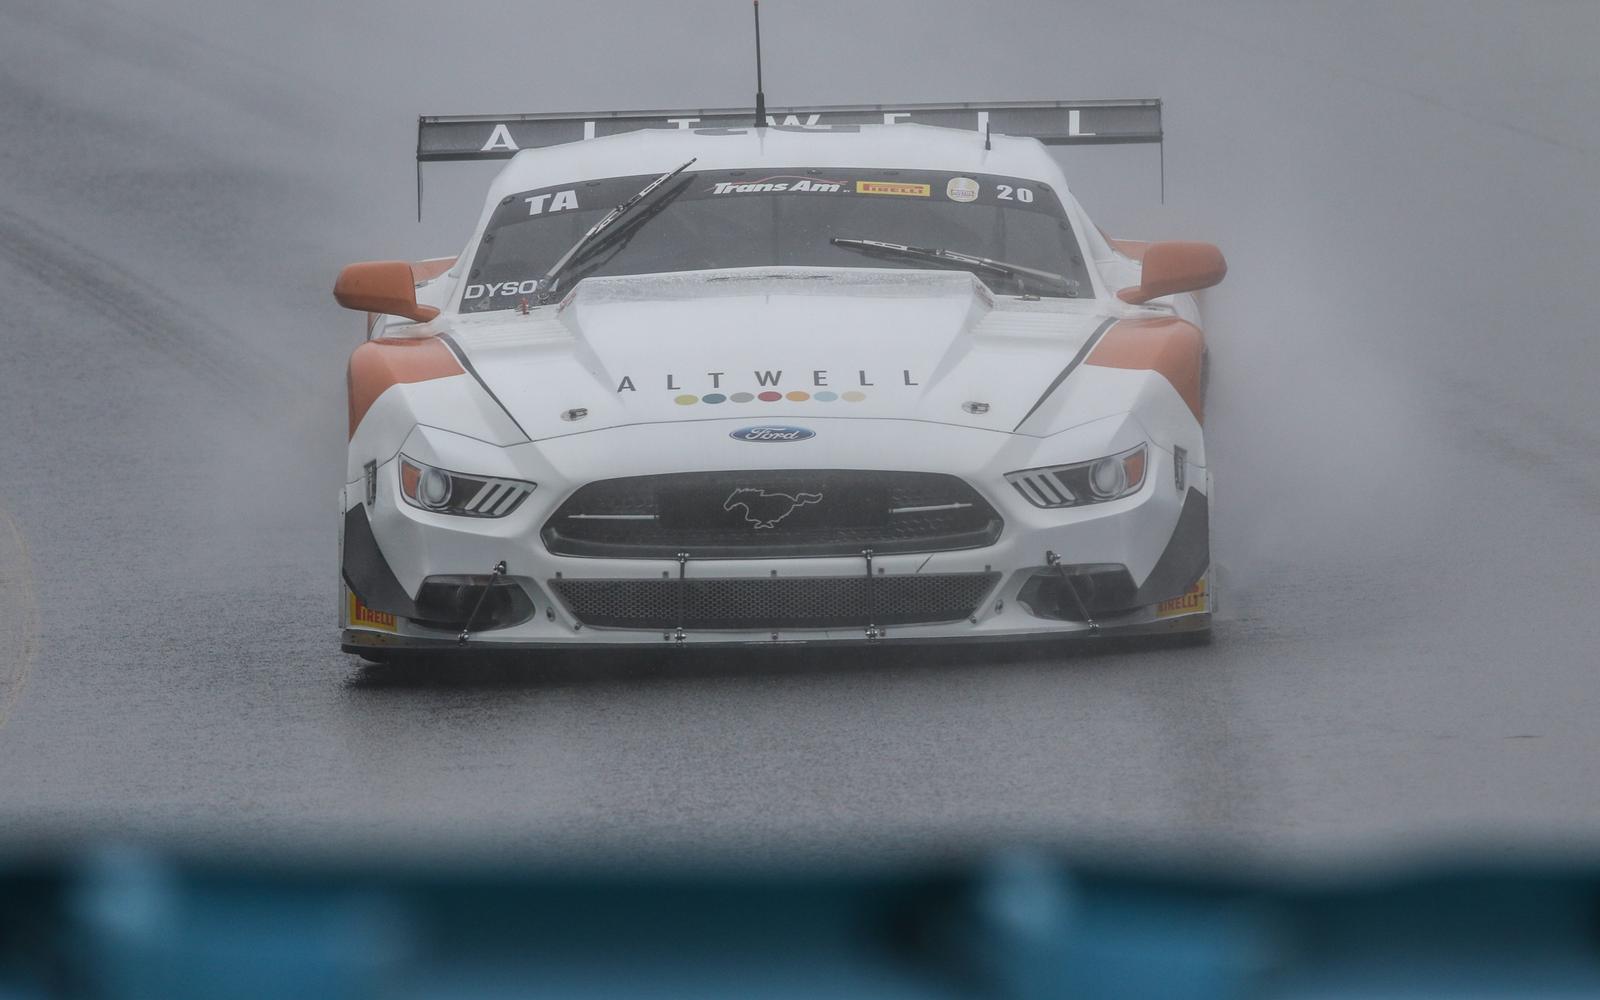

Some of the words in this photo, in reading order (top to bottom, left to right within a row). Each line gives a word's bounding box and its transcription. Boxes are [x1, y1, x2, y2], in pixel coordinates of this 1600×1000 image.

[713, 182, 789, 194] Trans
[788, 180, 840, 192] Am
[863, 183, 924, 194] PIRELLI
[996, 185, 1033, 203] 20
[525, 190, 579, 216] TA
[617, 370, 919, 392] ALTWELL
[745, 427, 800, 440] Ford
